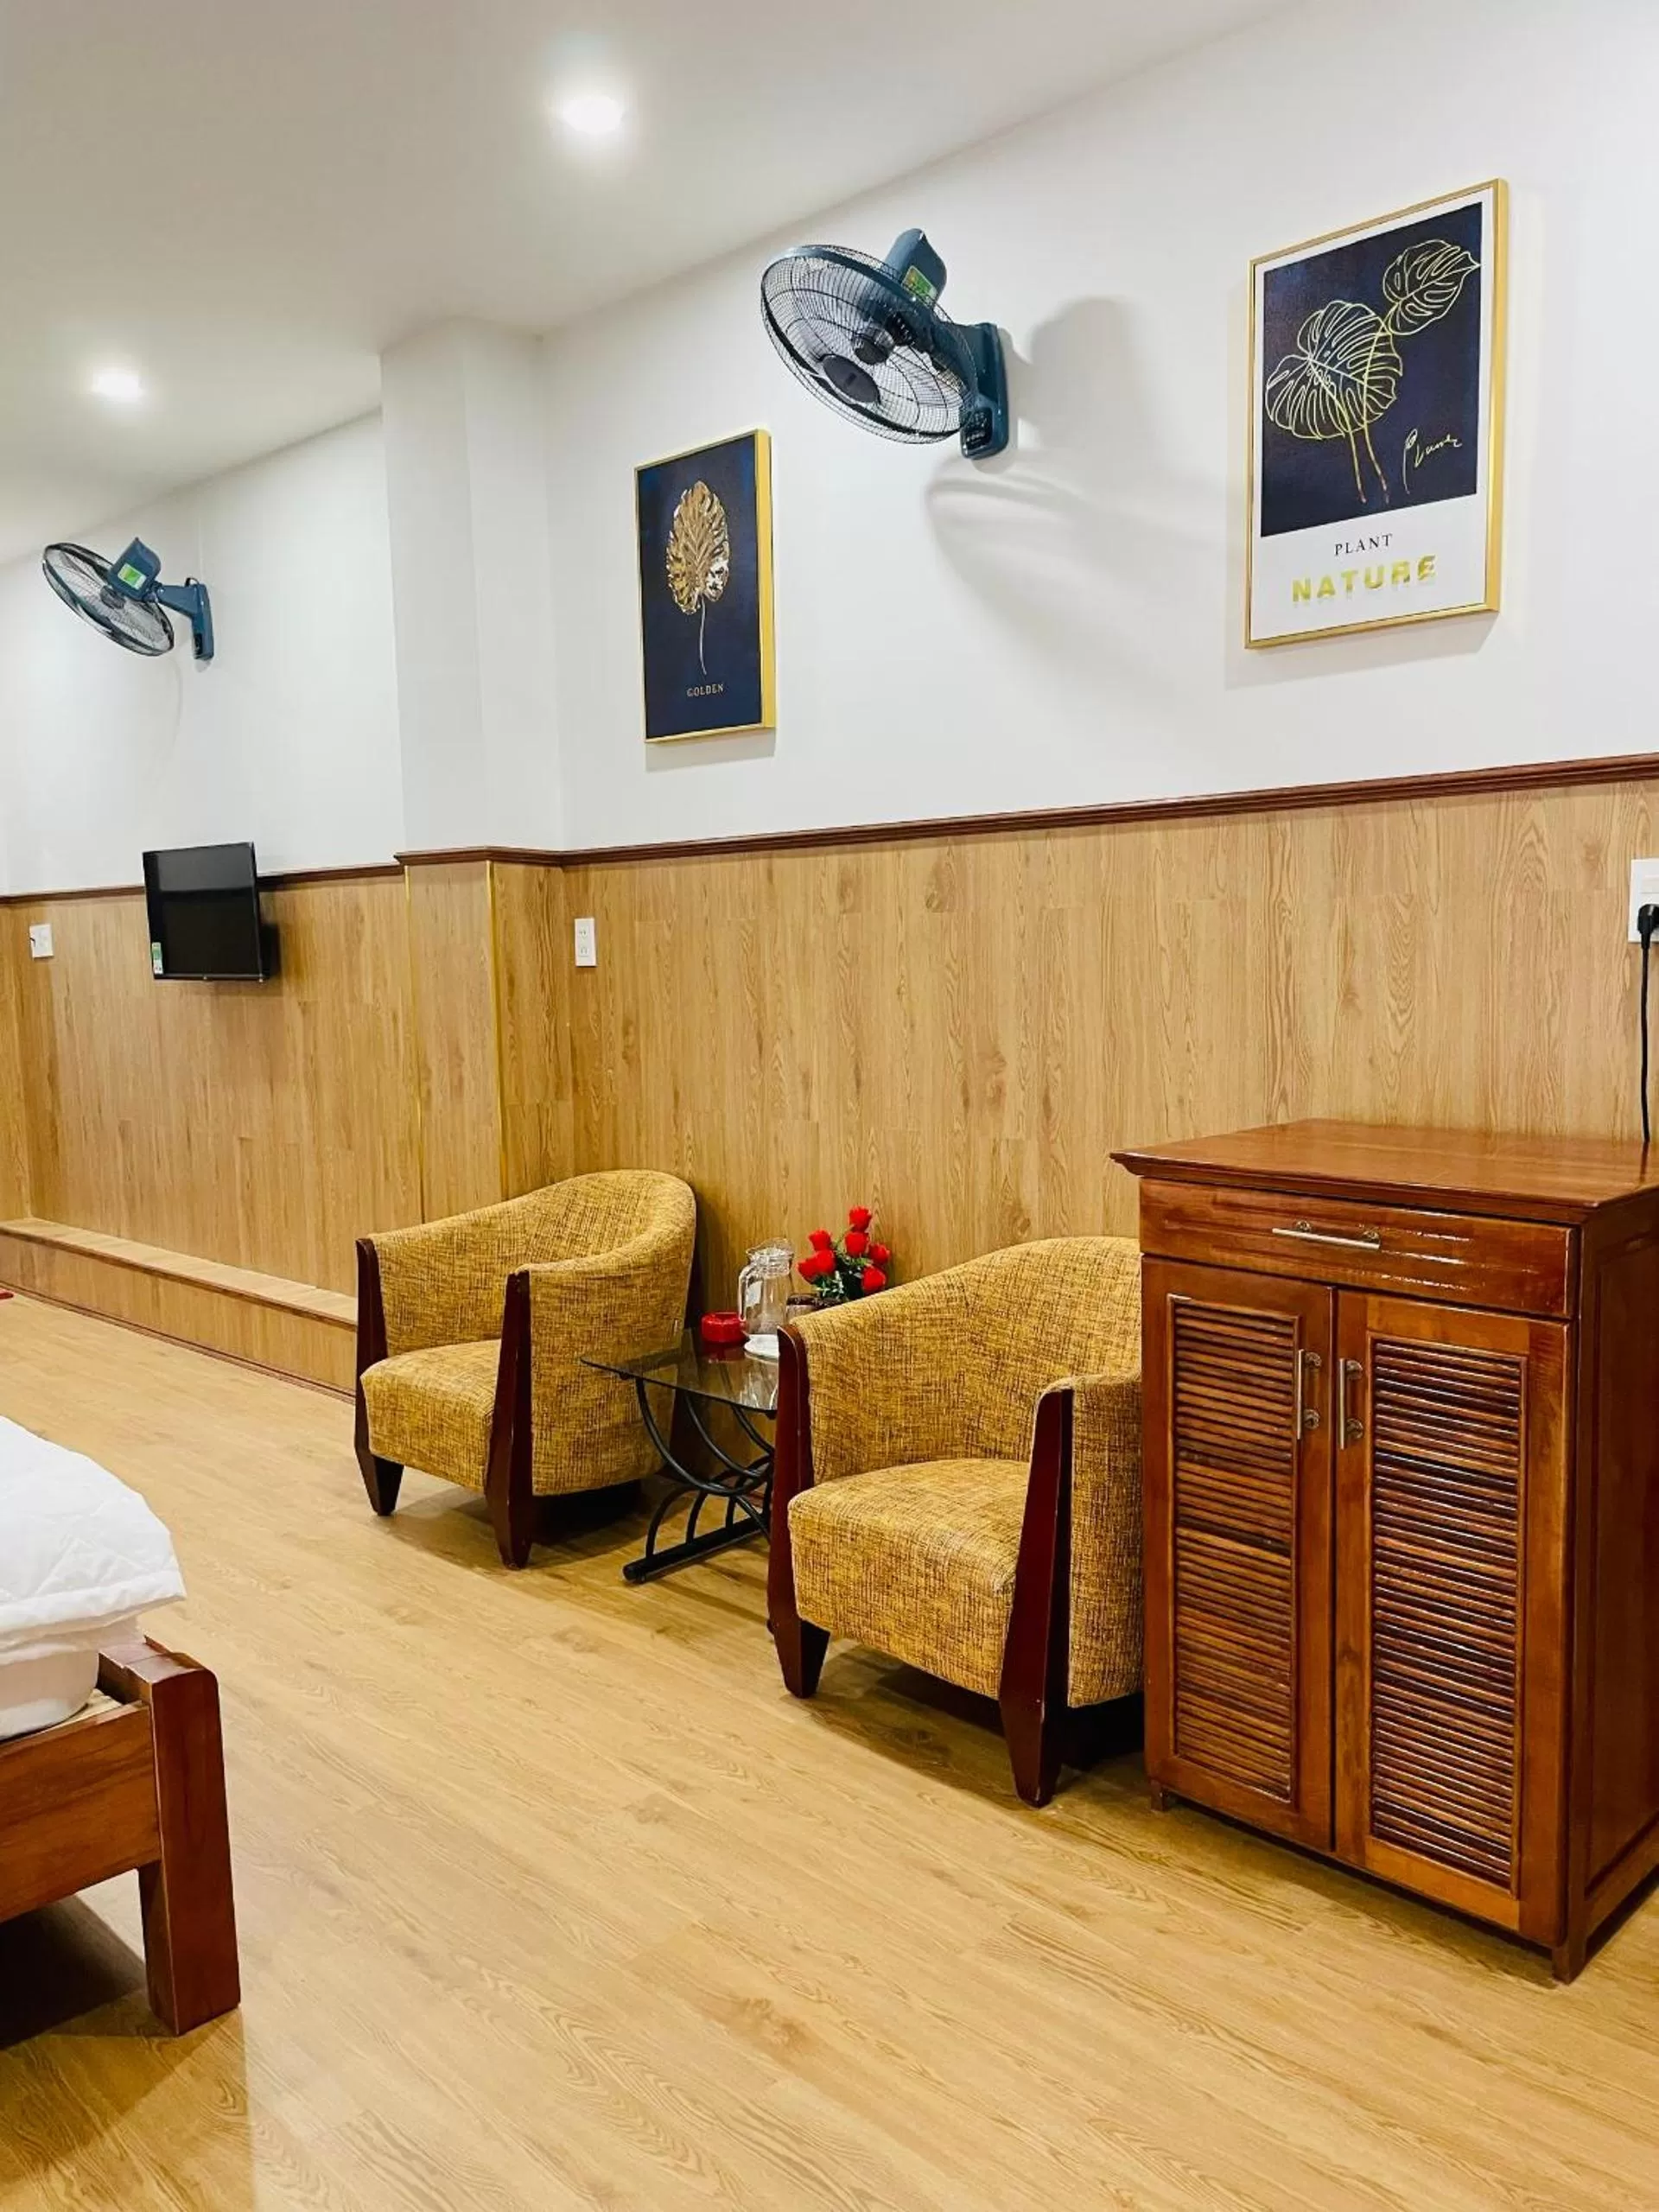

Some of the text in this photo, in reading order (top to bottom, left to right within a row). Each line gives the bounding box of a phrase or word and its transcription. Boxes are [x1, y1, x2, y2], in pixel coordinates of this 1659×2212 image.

[1334, 533, 1393, 556] PLANT
[1292, 555, 1436, 602] NATURE
[686, 683, 724, 697] GOLDEN
